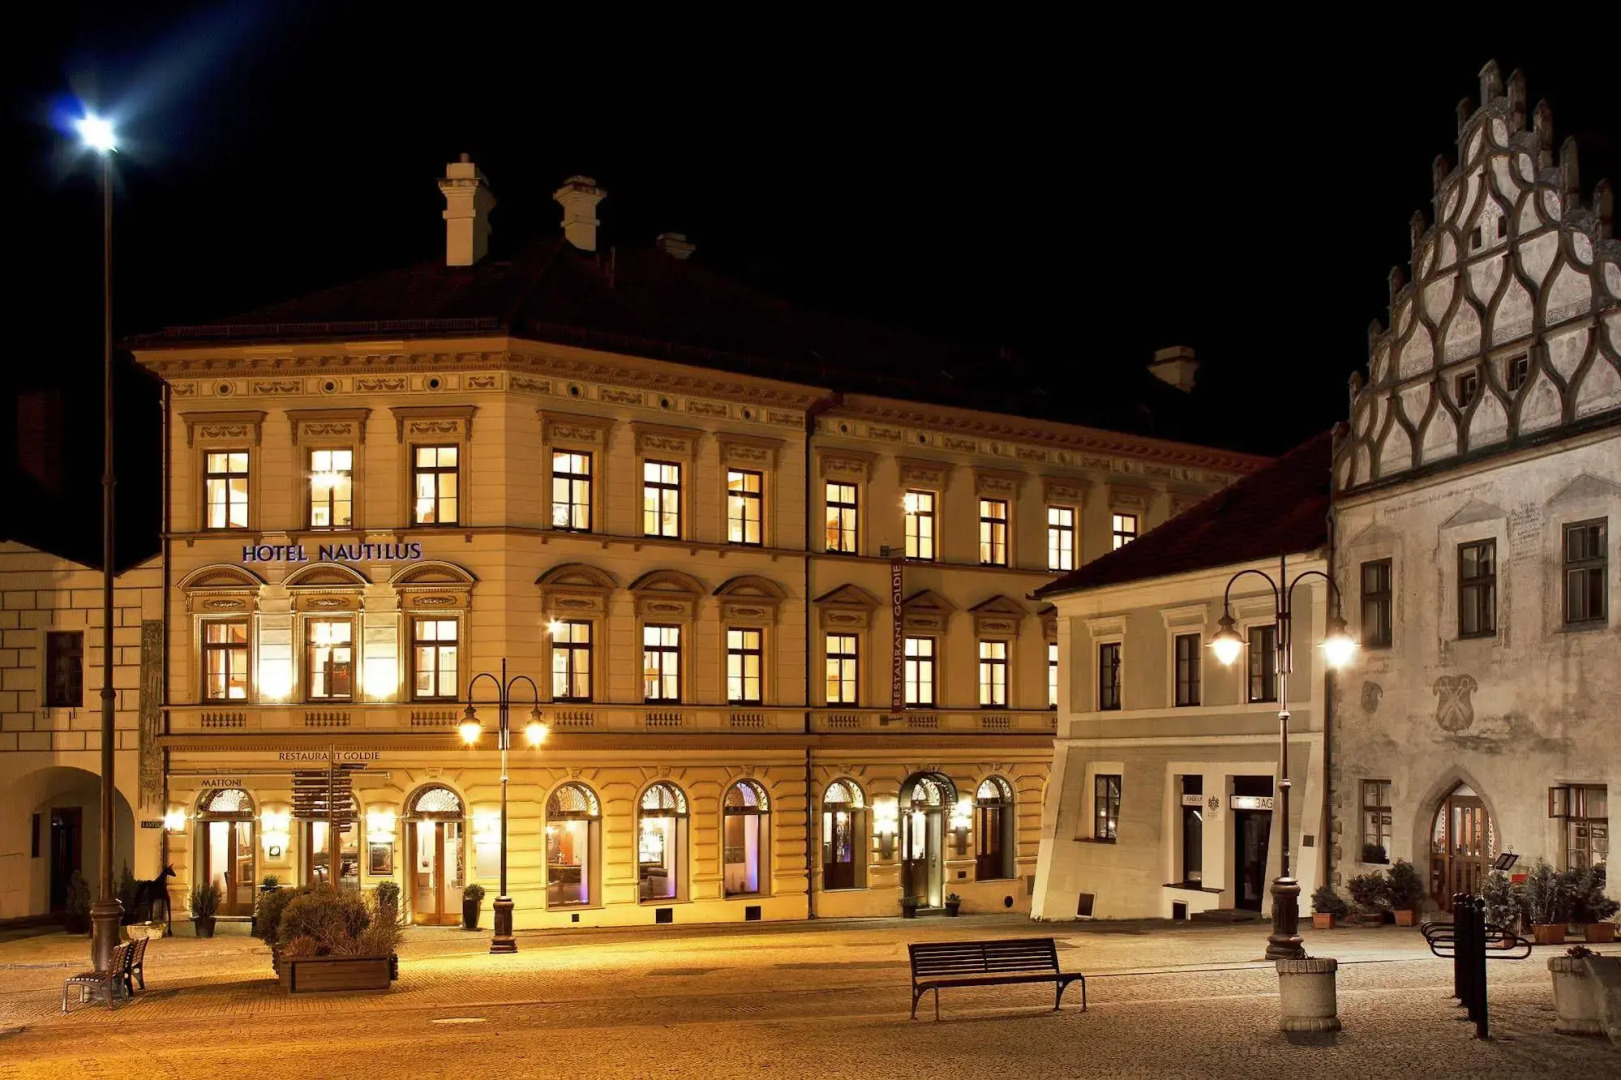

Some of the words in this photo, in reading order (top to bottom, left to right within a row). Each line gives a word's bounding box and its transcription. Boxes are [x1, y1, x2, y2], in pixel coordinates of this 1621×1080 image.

[243, 545, 308, 562] HOTEL
[319, 543, 422, 561] NAUTILUS
[893, 564, 901, 617] GOLDIE
[893, 621, 901, 706] RESTAURANT
[279, 752, 340, 760] RESTAURAT
[343, 752, 380, 760] GOLDIE
[201, 779, 242, 787] MATTONI
